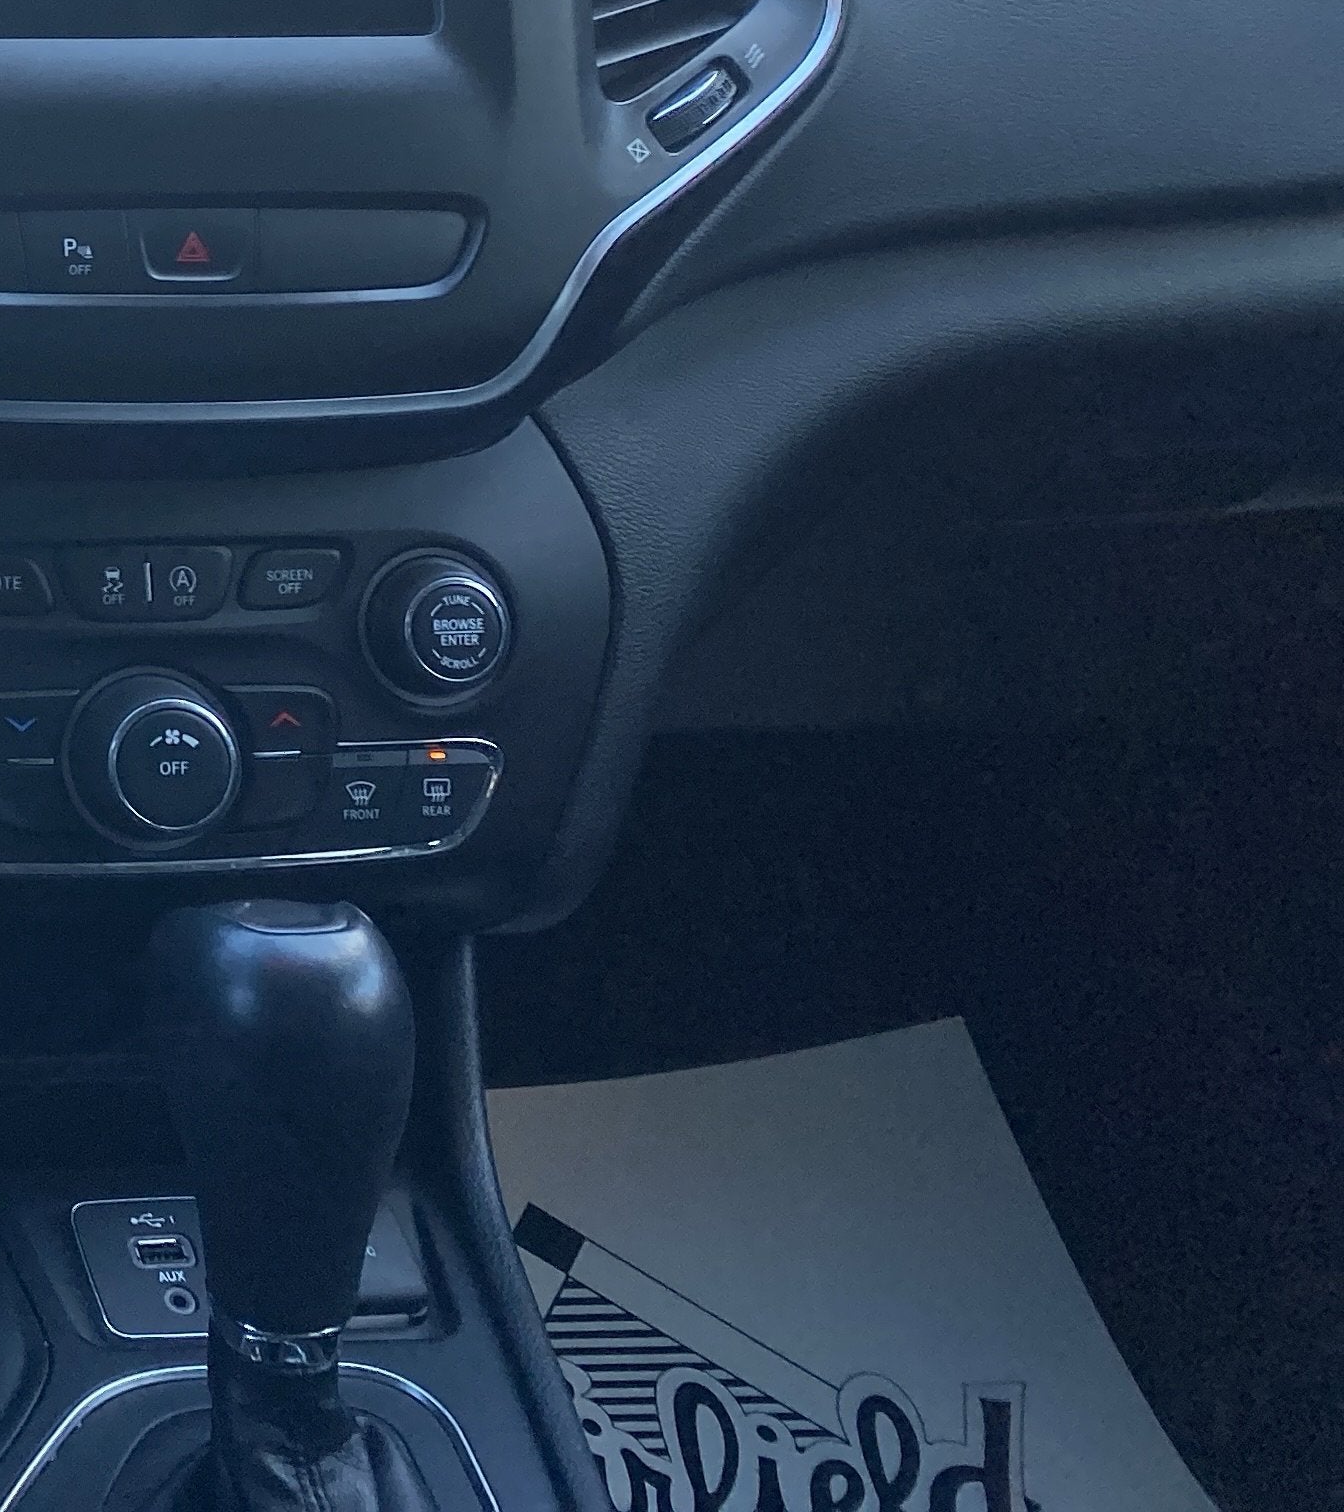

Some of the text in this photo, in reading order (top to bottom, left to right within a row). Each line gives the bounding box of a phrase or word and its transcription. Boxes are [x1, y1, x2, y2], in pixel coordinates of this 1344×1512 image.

[68, 264, 92, 276] OFF
[266, 569, 314, 583] SCREEN
[278, 582, 302, 595] OFF
[102, 593, 127, 606] OFF
[173, 595, 196, 607] OFF
[441, 594, 472, 608] TUNE
[433, 617, 485, 632] BROWSE
[440, 633, 480, 647] ENTER
[439, 654, 480, 669] SCROLL
[159, 761, 191, 776] OFF
[343, 808, 381, 821] FRONT
[422, 804, 452, 817] REAR
[159, 1270, 186, 1283] AUX
